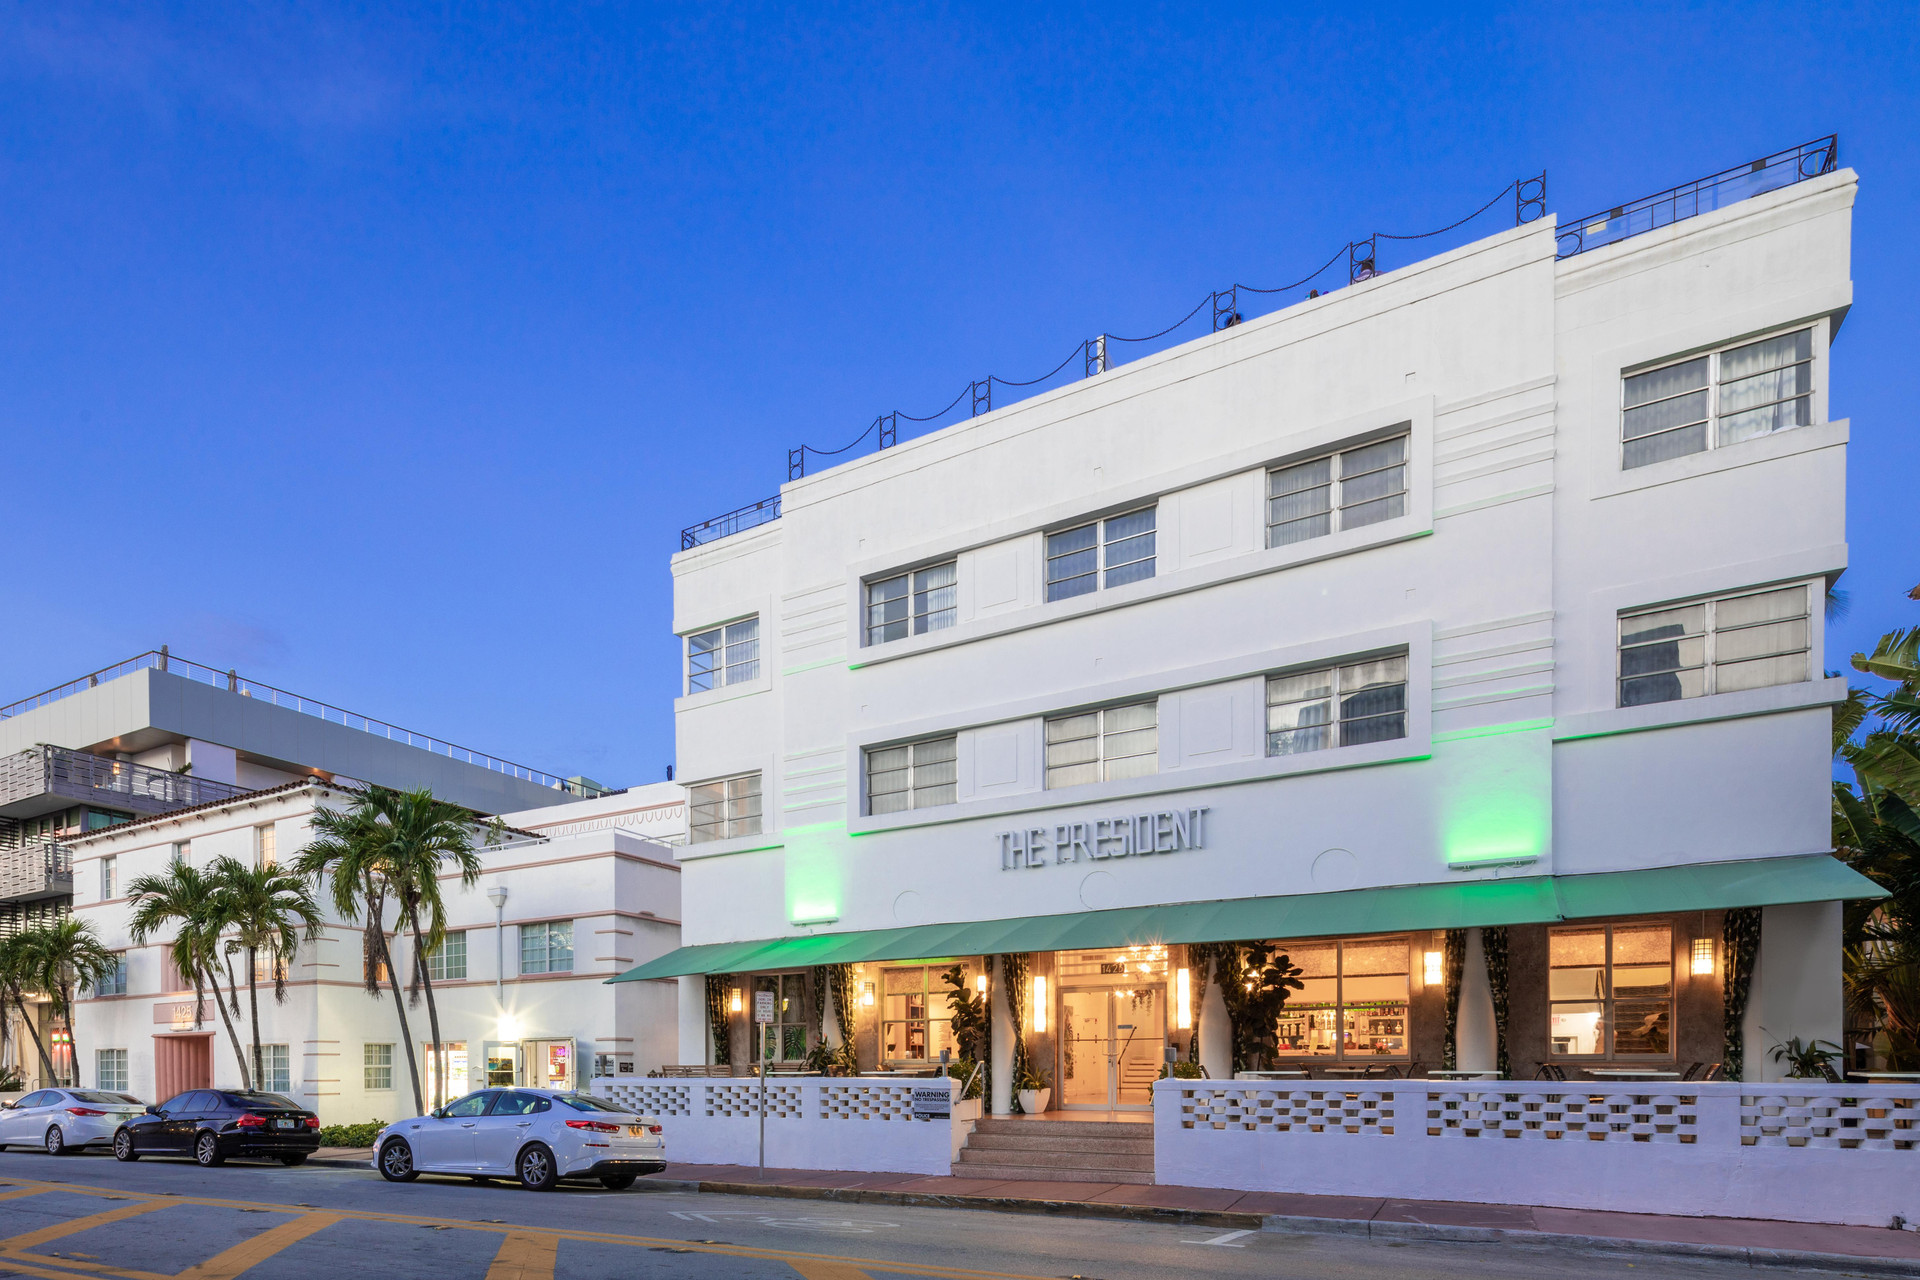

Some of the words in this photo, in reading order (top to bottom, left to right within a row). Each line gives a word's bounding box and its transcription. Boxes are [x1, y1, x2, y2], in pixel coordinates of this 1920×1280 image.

[995, 827, 1045, 871] THE
[1054, 807, 1210, 864] PRESIDENT
[173, 1005, 192, 1019] 1425
